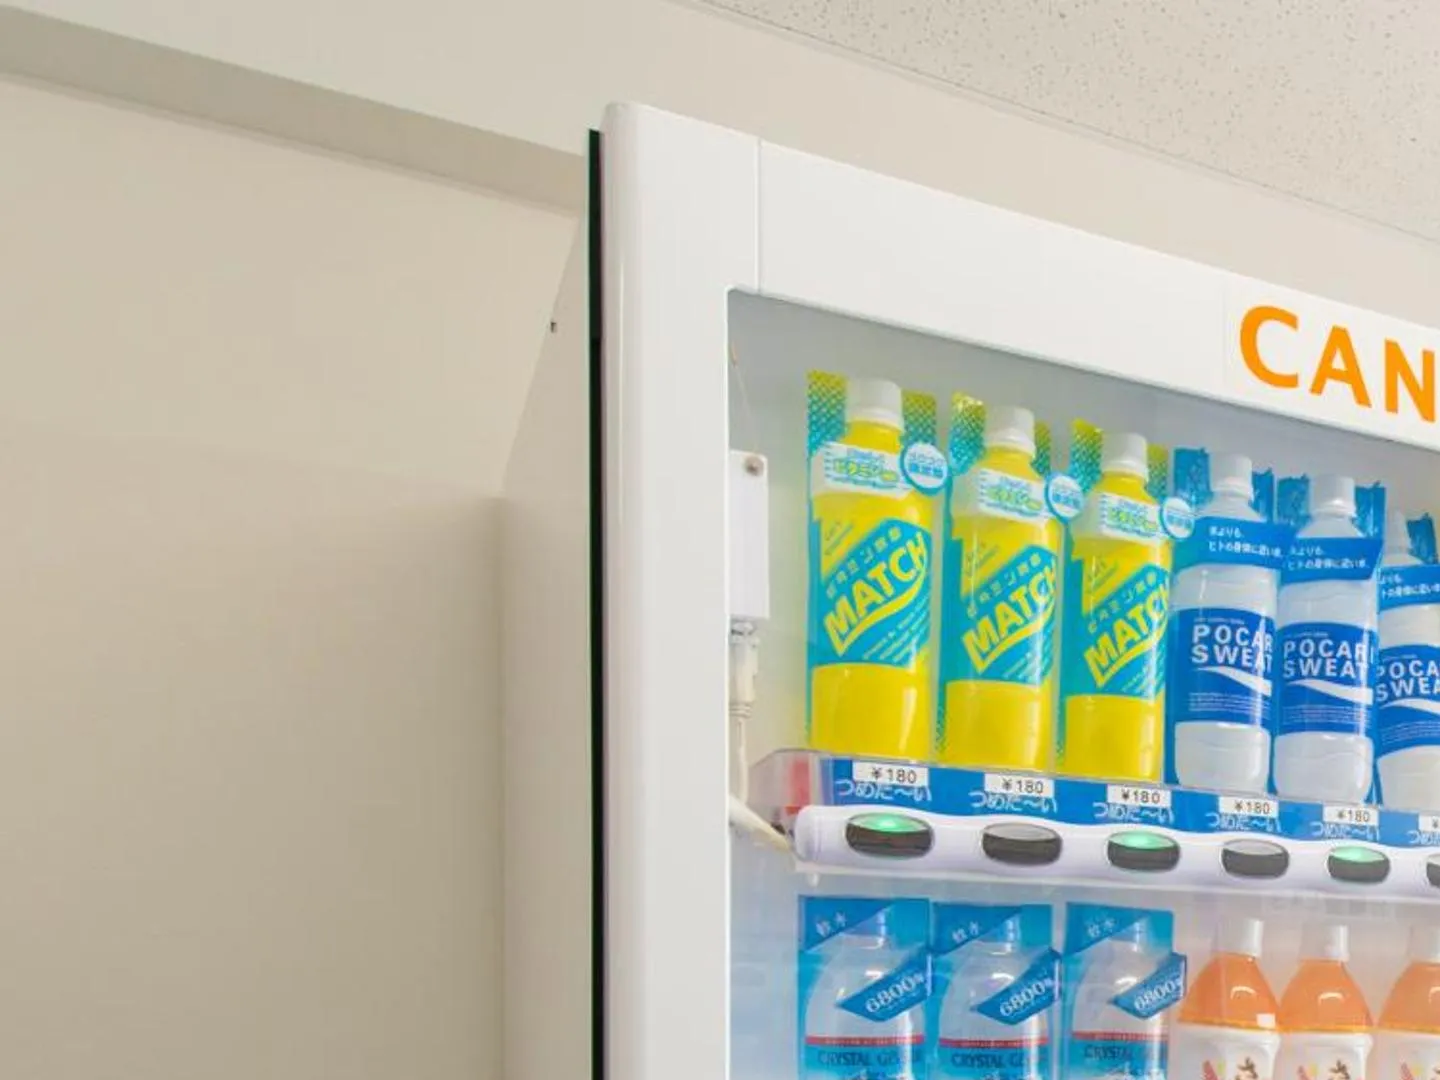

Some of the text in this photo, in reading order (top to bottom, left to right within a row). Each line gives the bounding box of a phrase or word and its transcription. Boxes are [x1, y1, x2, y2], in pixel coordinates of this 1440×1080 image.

[824, 531, 928, 657] MATCH
[1192, 624, 1273, 653] POCAR
[1190, 645, 1273, 673] SWEAT
[1283, 659, 1369, 678] SWEAT
[871, 766, 918, 784] ¥180
[1001, 775, 1045, 794] ¥180
[1121, 788, 1161, 804] ¥180
[1233, 801, 1272, 816] ¥180
[1336, 809, 1371, 824] ¥180
